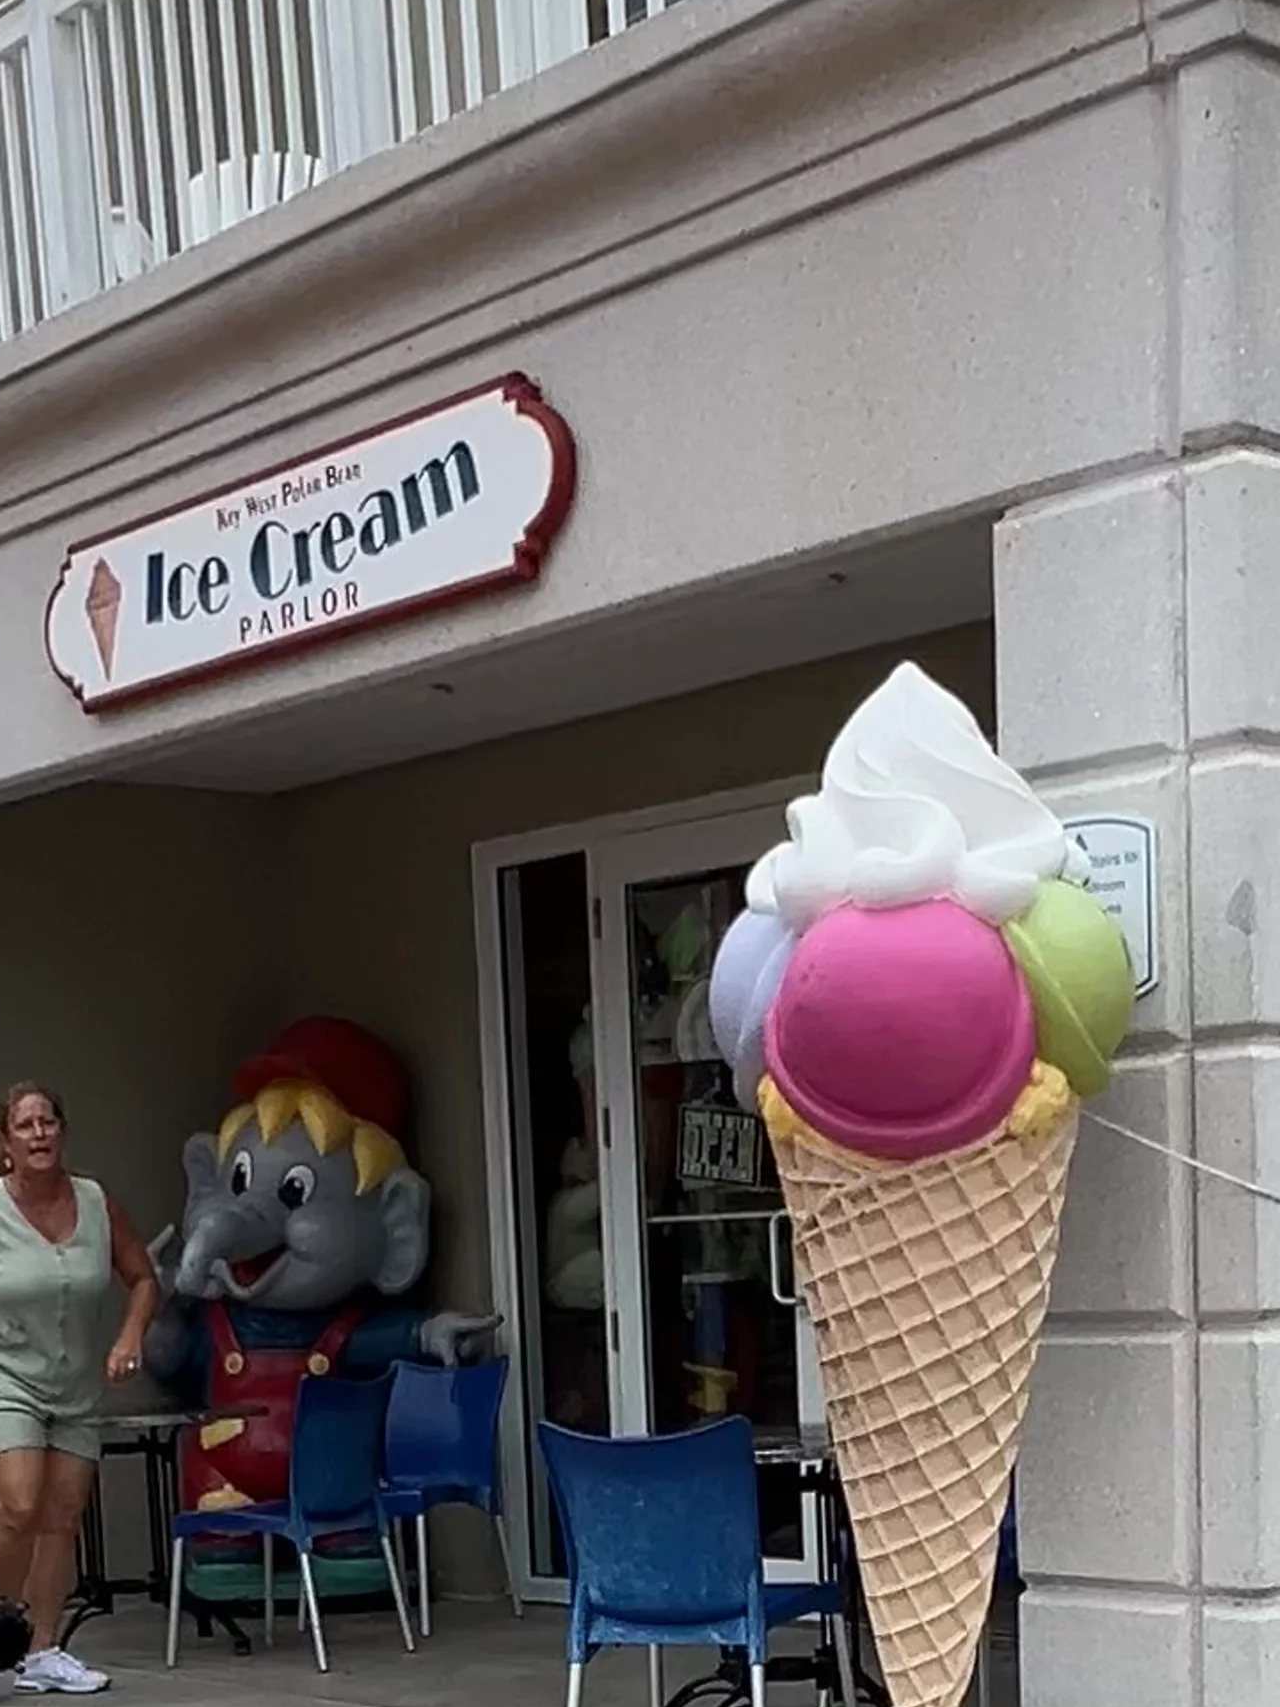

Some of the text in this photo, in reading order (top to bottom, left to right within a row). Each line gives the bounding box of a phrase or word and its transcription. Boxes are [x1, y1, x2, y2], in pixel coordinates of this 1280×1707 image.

[145, 440, 480, 625] Ice Cream
[238, 580, 359, 642] PARLOR
